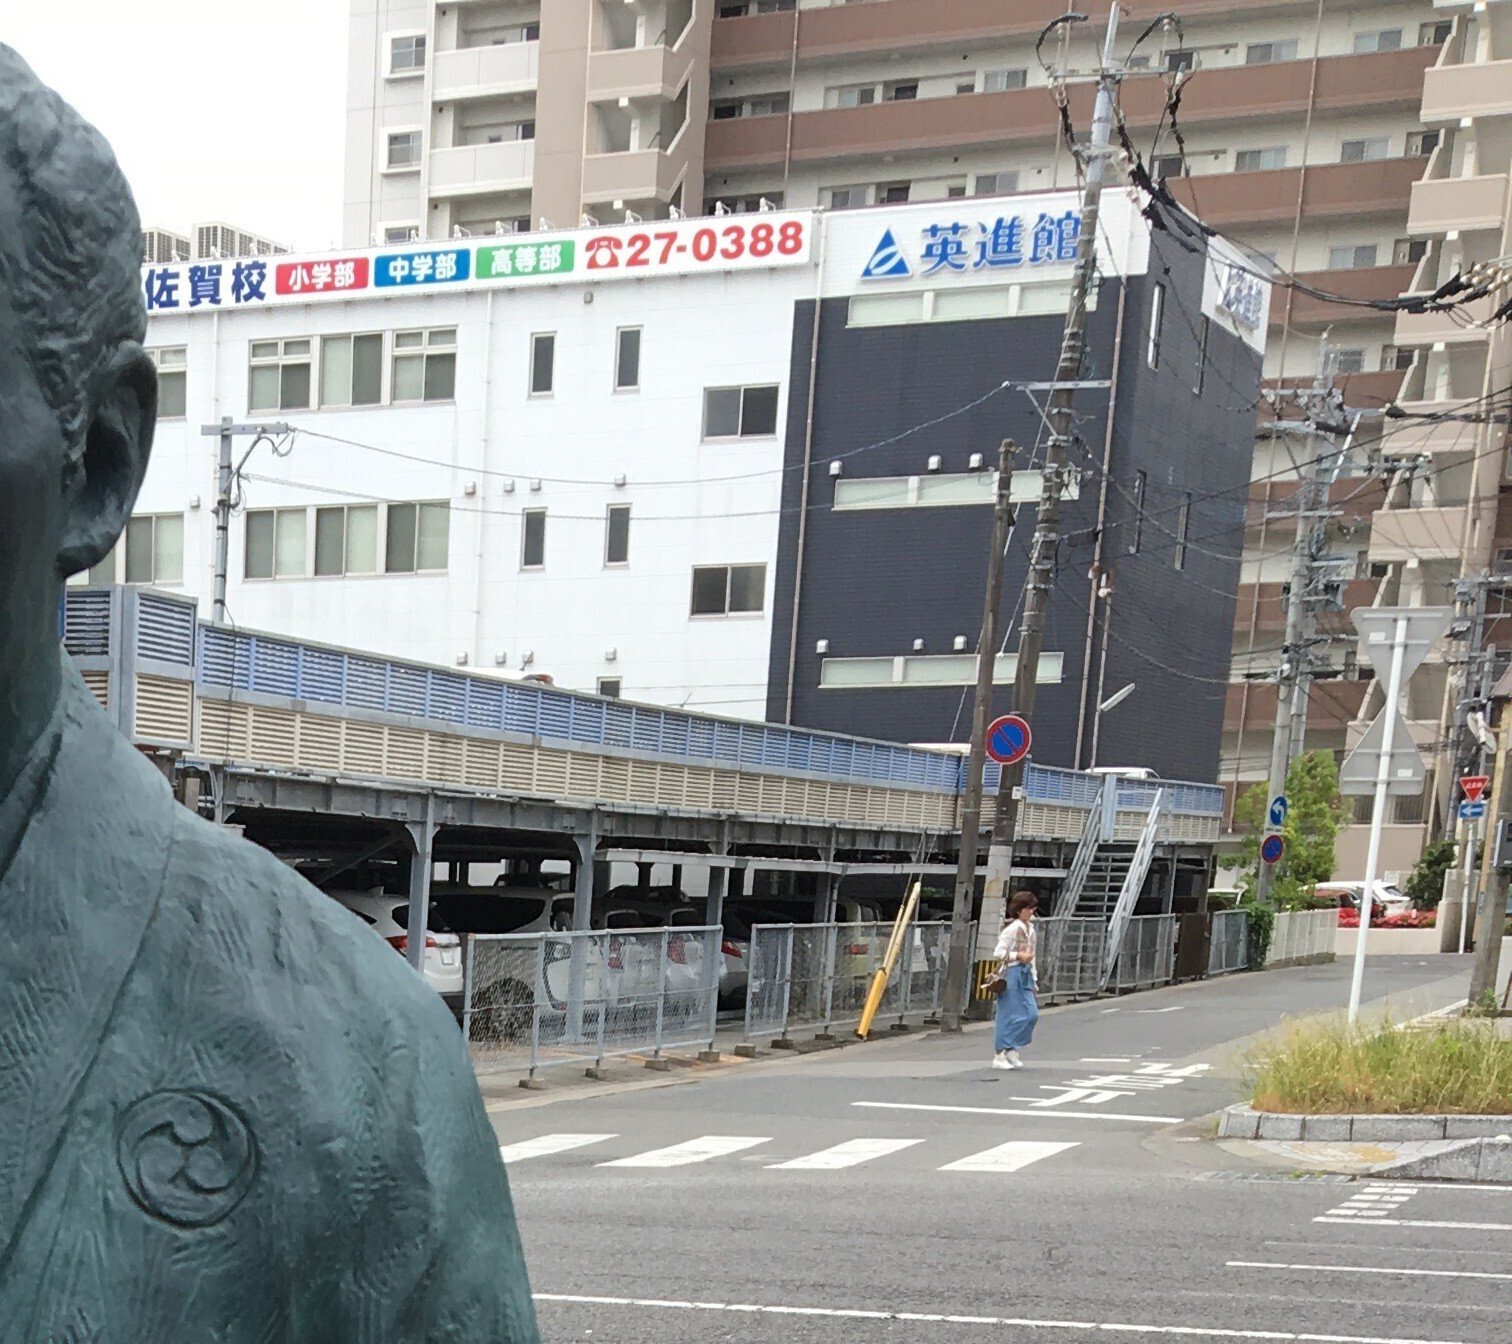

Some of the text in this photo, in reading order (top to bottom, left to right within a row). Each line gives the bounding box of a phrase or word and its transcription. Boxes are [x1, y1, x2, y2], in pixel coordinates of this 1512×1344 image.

[145, 220, 803, 310] 佐賀校 小学部 中学部 高等部 27-0388
[920, 210, 1082, 274] 英進館
